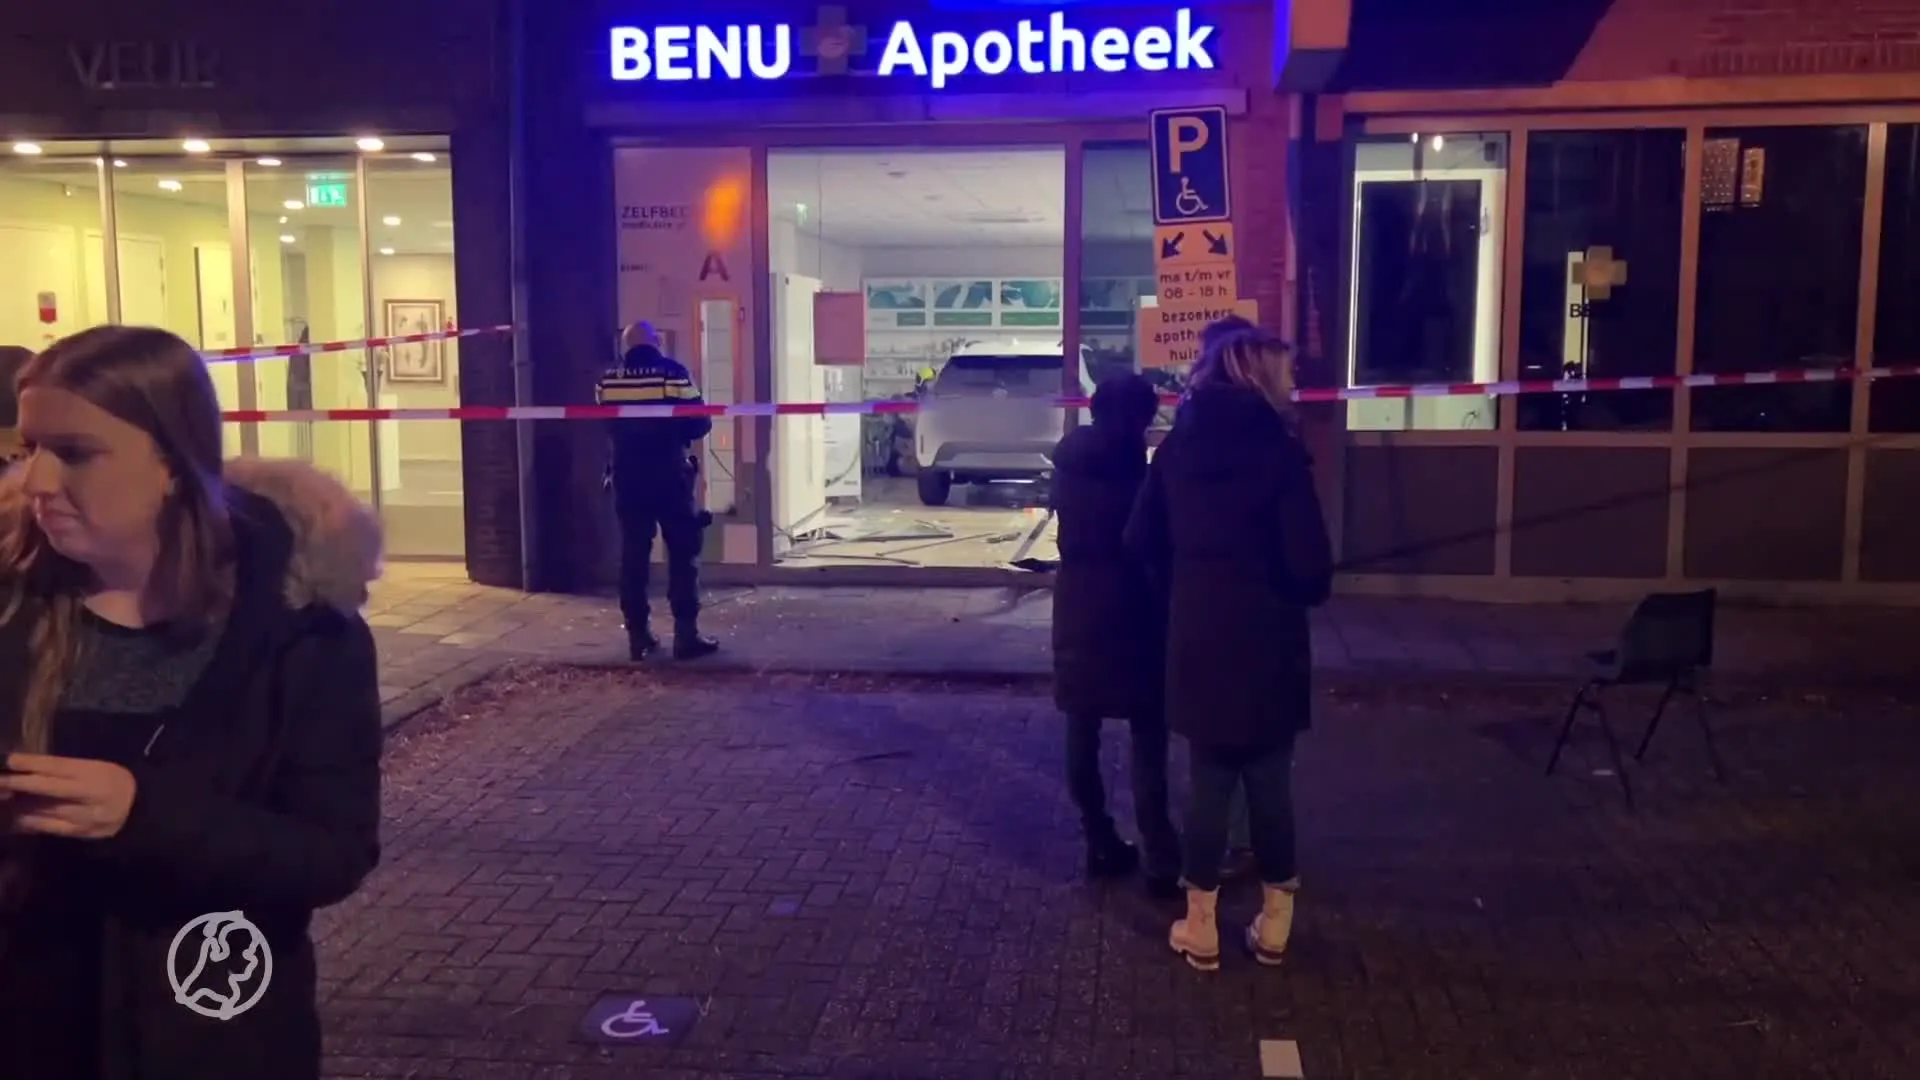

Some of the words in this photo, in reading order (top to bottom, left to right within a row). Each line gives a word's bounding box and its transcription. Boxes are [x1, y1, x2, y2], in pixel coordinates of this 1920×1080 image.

[610, 23, 791, 80] BENU
[878, 8, 1215, 87] Apotheek
[1168, 116, 1209, 174] P
[1160, 273, 1180, 284] ma
[1185, 269, 1213, 282] t/m
[1217, 269, 1232, 280] vr
[1164, 287, 1183, 299] 08
[1199, 286, 1214, 298] 18
[1218, 284, 1227, 297] h
